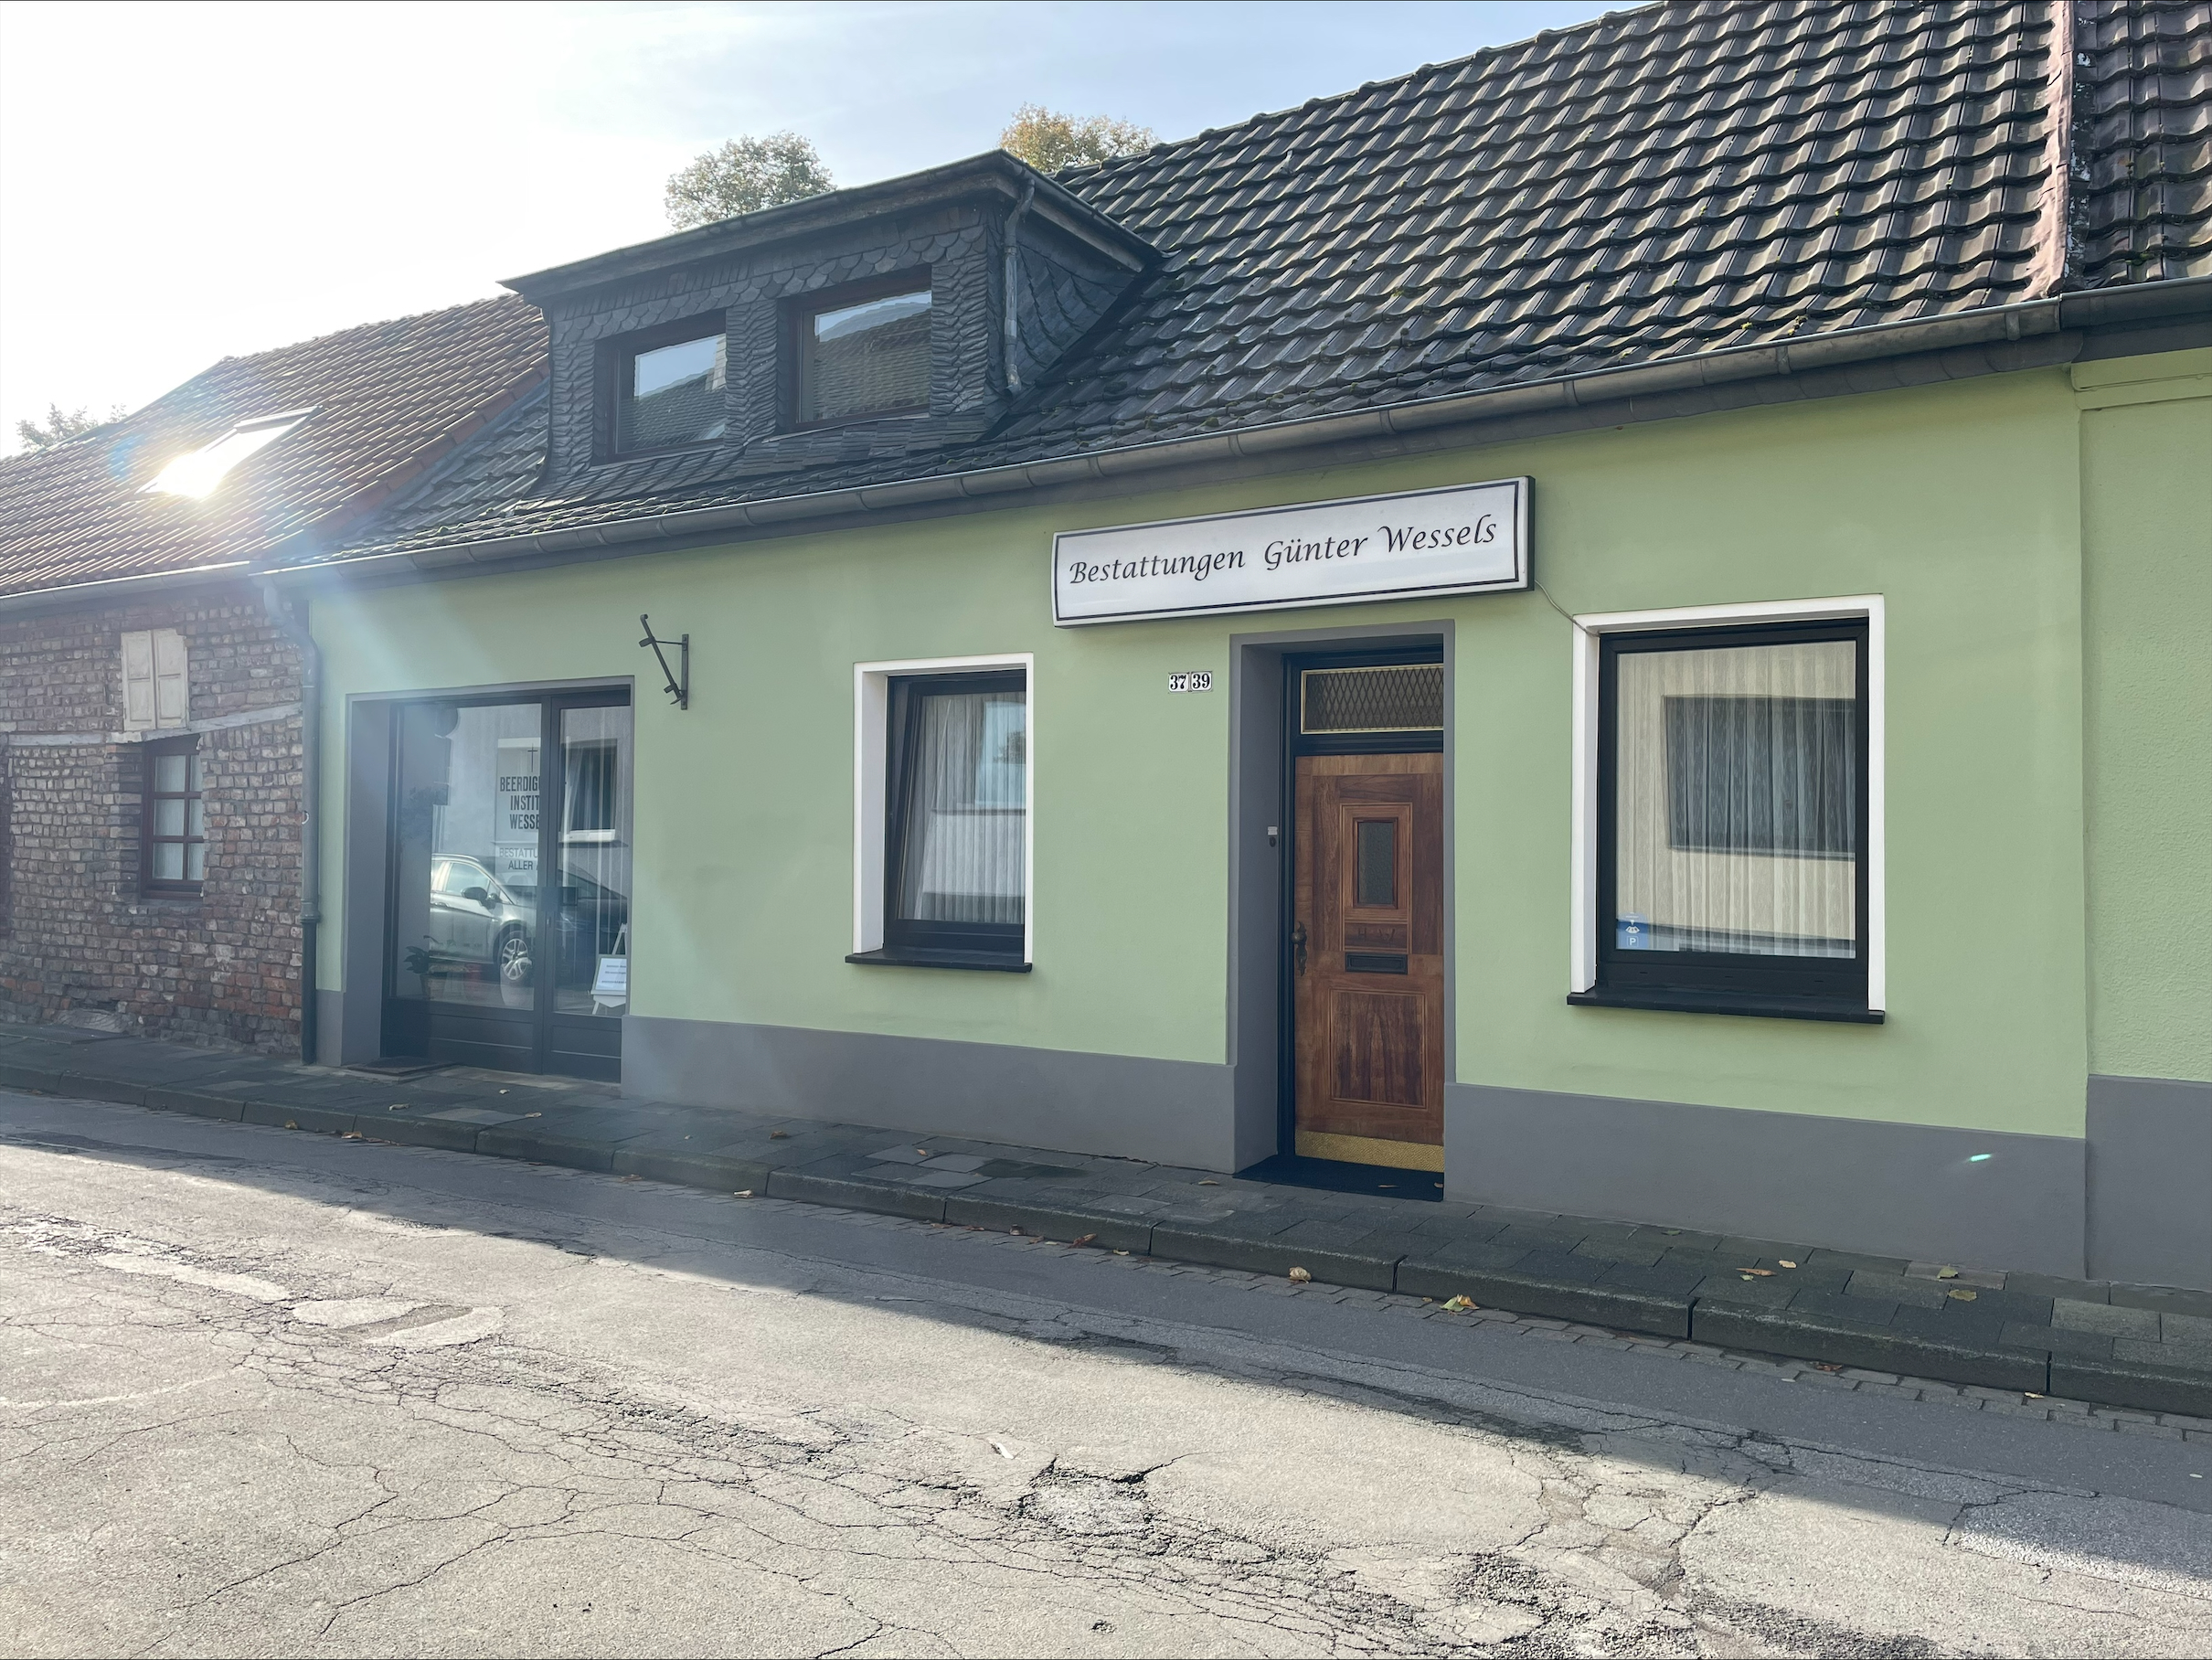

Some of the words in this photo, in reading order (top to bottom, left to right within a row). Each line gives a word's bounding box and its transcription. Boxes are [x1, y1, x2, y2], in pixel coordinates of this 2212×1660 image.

[1069, 549, 1246, 584] Bestattungen
[1263, 536, 1369, 571] Günter
[1377, 514, 1497, 553] Wessels
[1169, 674, 1187, 690] 37
[1192, 673, 1210, 689] 39
[499, 775, 540, 792] BEERDIG
[507, 860, 534, 870] ALLER
[1629, 937, 1637, 946] P
